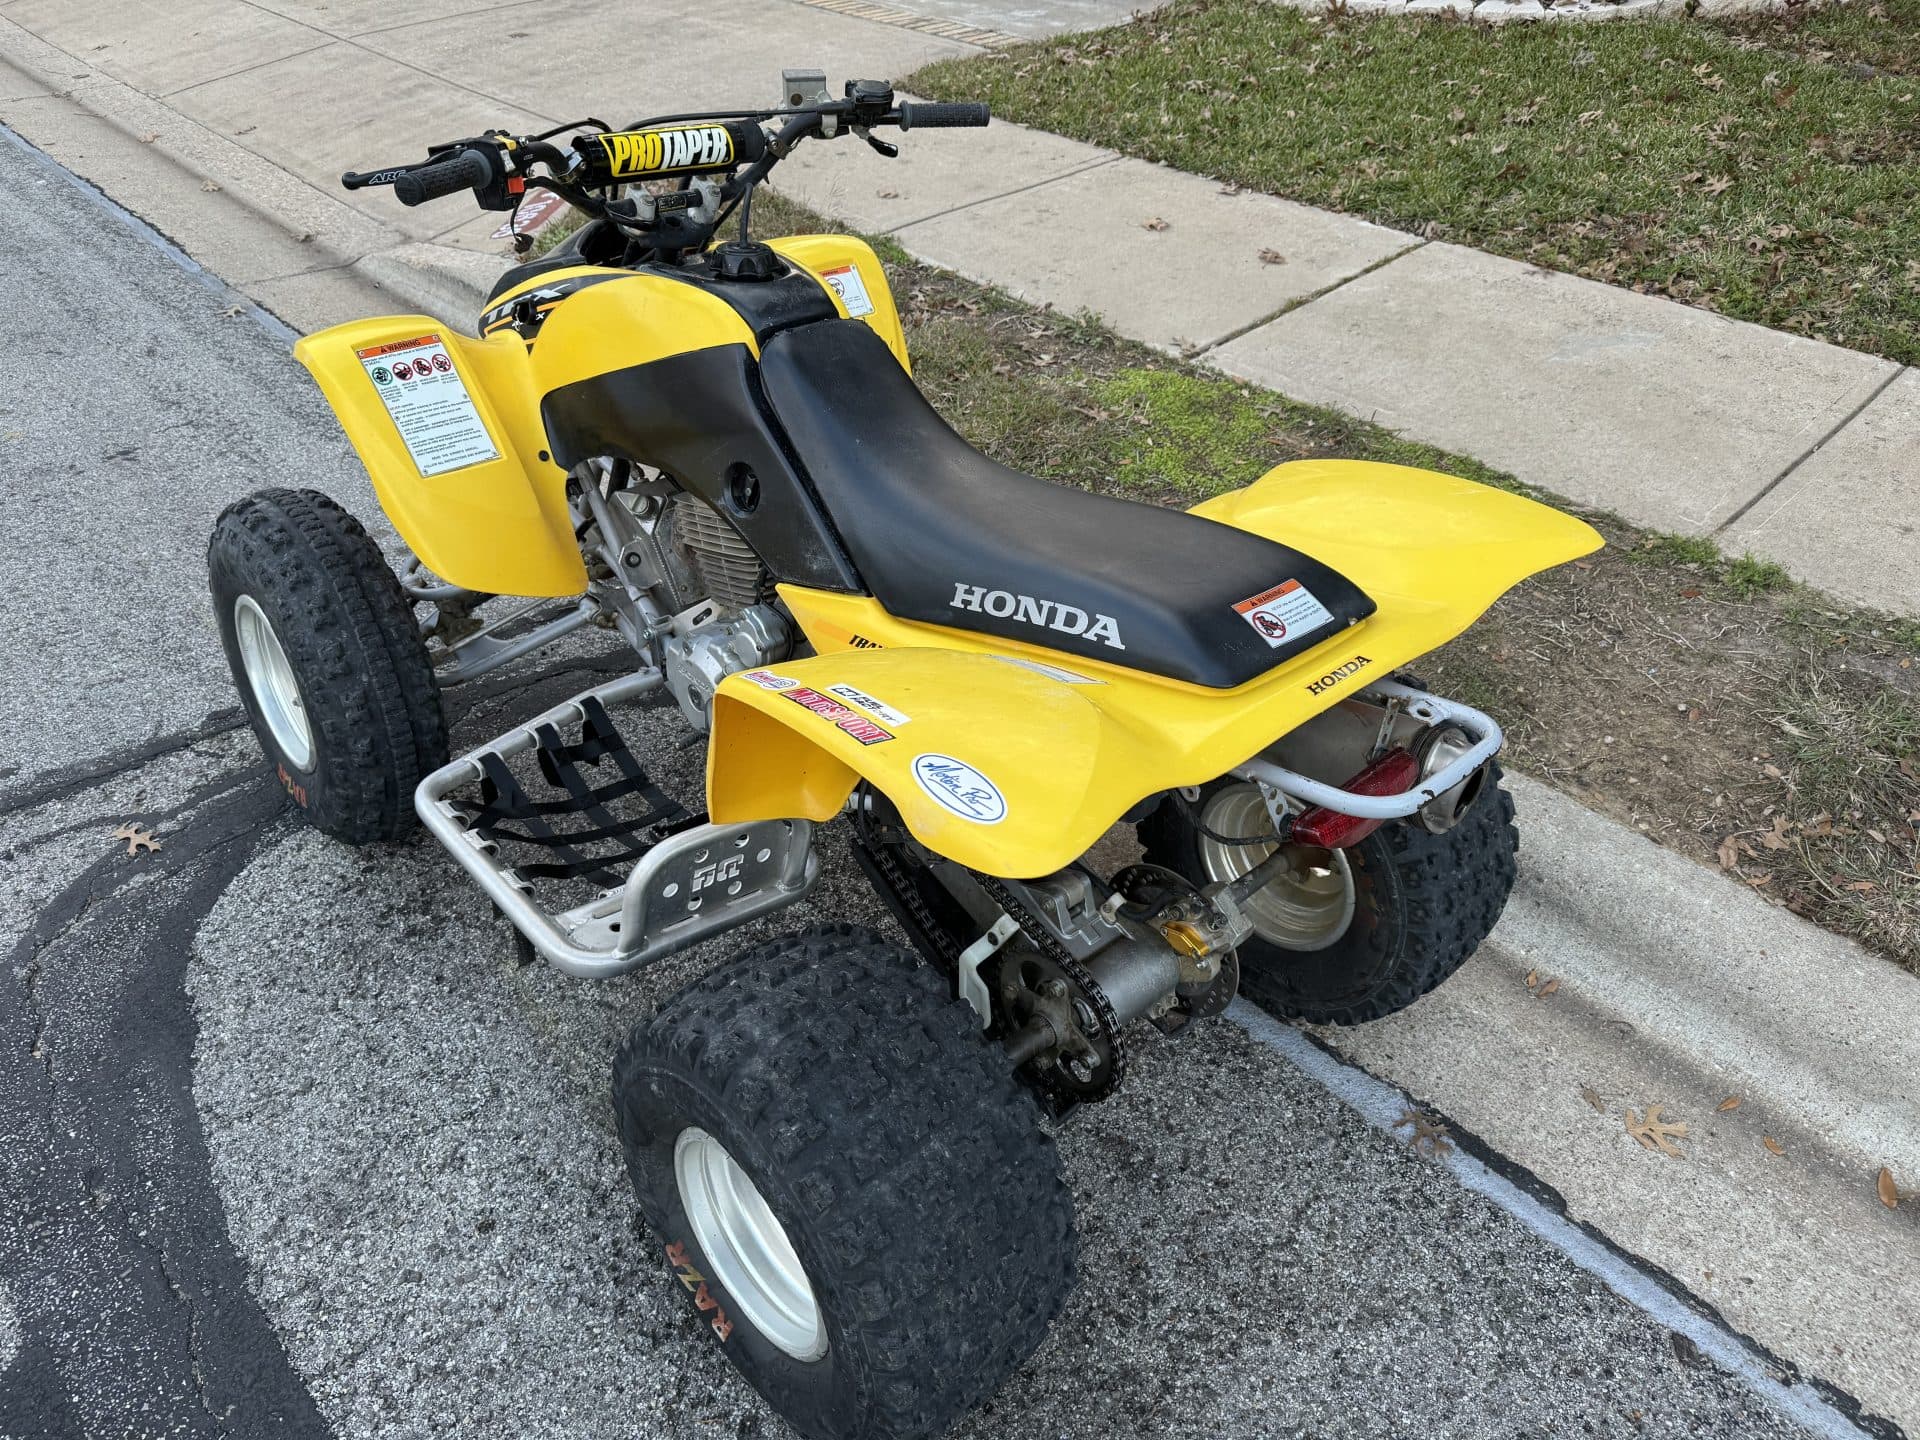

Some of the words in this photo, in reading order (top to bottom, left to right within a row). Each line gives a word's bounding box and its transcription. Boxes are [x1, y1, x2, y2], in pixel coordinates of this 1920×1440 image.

[612, 127, 728, 174] PROTAPER
[388, 339, 421, 352] WARNING
[949, 582, 1126, 651] HONDA
[1257, 588, 1285, 604] WARNING
[1305, 655, 1373, 696] HONDA
[921, 762, 964, 794] Motion
[961, 787, 993, 811] Pro
